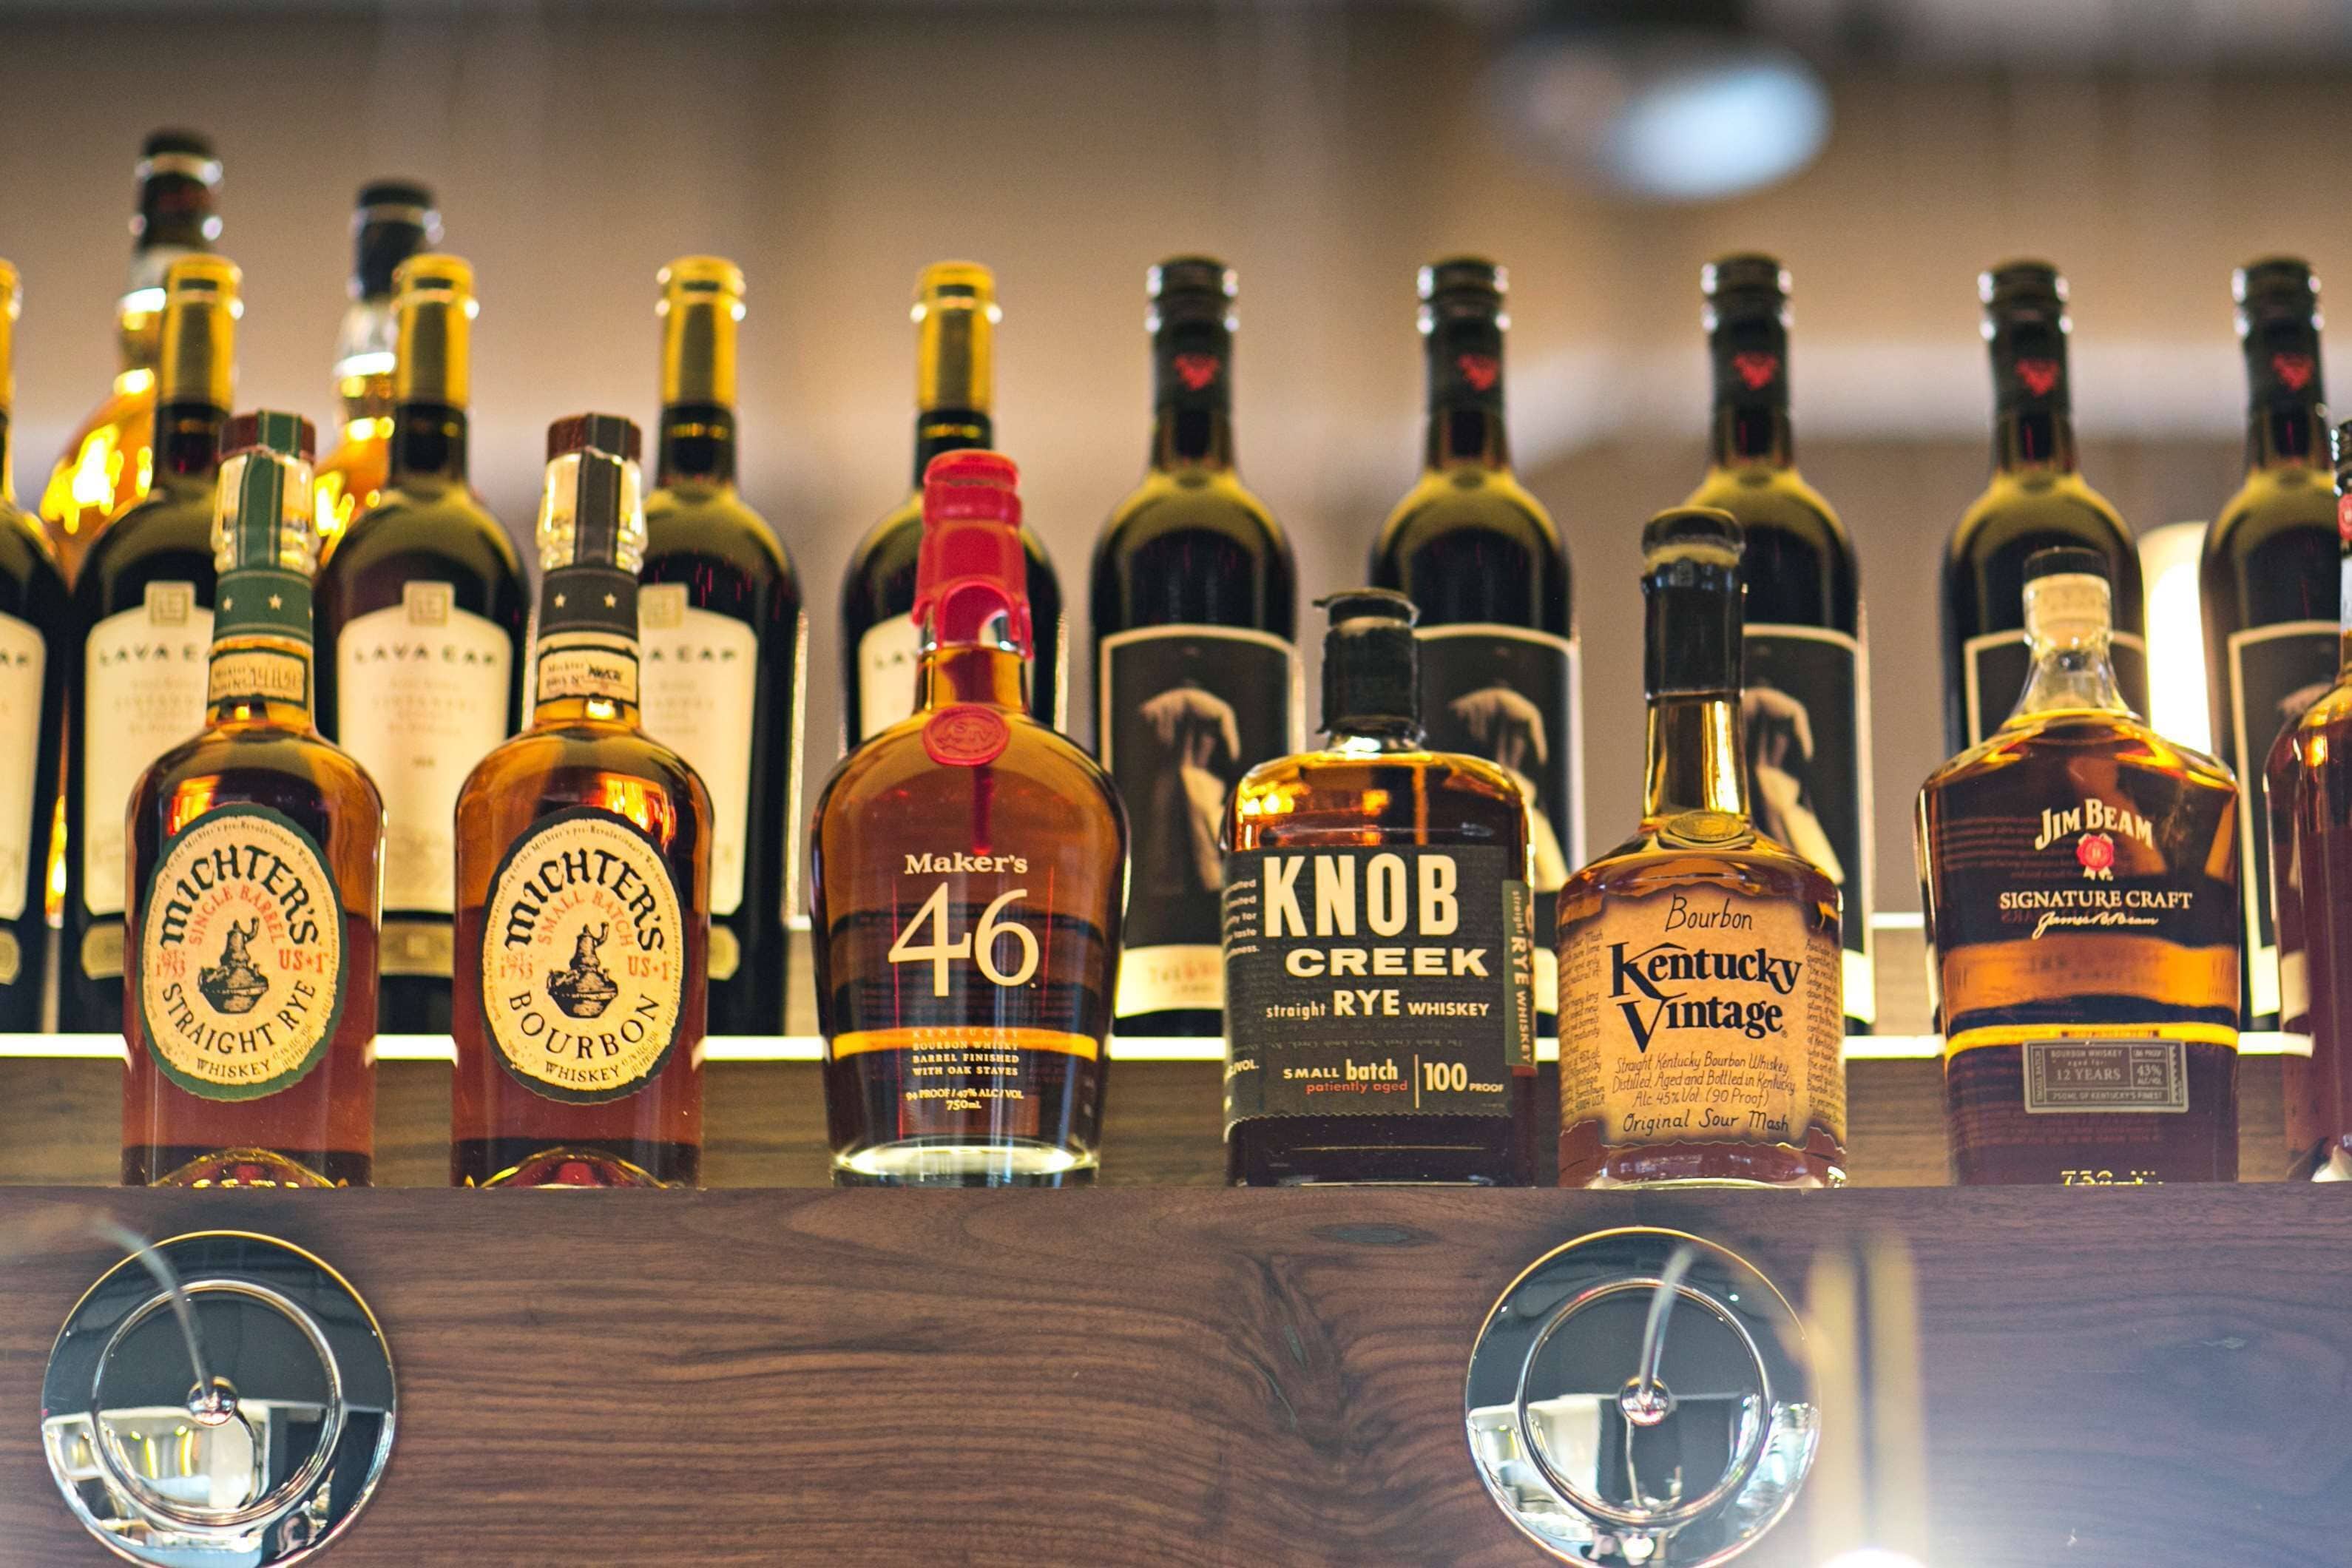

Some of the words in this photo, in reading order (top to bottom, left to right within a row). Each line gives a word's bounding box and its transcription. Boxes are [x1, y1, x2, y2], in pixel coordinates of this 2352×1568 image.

[2035, 807, 2081, 851] JIM
[2084, 798, 2154, 850] BEAM
[904, 853, 1028, 875] Maker's
[160, 844, 320, 950] MICHTER'S
[504, 848, 664, 951] MICHTER'S
[1263, 853, 1459, 938] KNOB
[1999, 891, 2122, 909] SIGNATURE
[2125, 891, 2193, 909] CRAFT
[189, 885, 233, 947] SINGLE
[240, 885, 285, 943] BARREL
[538, 890, 585, 945] SMALL
[592, 890, 634, 947] BATCH
[1511, 891, 1525, 934] straight
[1665, 893, 1753, 931] Bourbon
[888, 882, 1039, 997] 46
[1285, 947, 1490, 978] CREEK
[1511, 936, 1531, 986] RYE
[1606, 942, 1803, 998] Kentucky
[163, 983, 275, 1054] STRAIGHT
[277, 979, 315, 1031] RYE
[1266, 1001, 1325, 1021] straight
[1334, 989, 1400, 1016] RYE
[1408, 1002, 1490, 1017] WHISKEY
[510, 991, 660, 1060] BOURBON
[912, 1029, 1018, 1038] KENTUCKY
[1515, 990, 1532, 1063] WHISKEY
[1617, 996, 1783, 1053] Vintage
[912, 1041, 968, 1051] BOURBON
[973, 1041, 1018, 1051] WHISKY
[912, 1054, 958, 1064] BARREL
[962, 1053, 1020, 1064] FINISHED
[197, 1058, 270, 1078] WHISKEY
[545, 1061, 620, 1082] WHISKEY
[912, 1067, 943, 1076] WITH
[947, 1066, 972, 1075] OAK
[976, 1067, 1018, 1076] STAVES
[1283, 1068, 1339, 1079] SMALL
[1345, 1058, 1399, 1081] batch
[1423, 1062, 1467, 1092] 100
[1469, 1083, 1504, 1092] PROOF
[1616, 1053, 1652, 1074] Straight
[1655, 1051, 1700, 1069] Kentucky
[1704, 1051, 1746, 1067] Bourbon
[2057, 1069, 2070, 1081] 12
[2075, 1068, 2121, 1081] YEARS
[1306, 1081, 1368, 1095] patiently
[1373, 1080, 1408, 1094] aged
[1655, 1071, 1681, 1090] Aged
[1684, 1071, 1703, 1086] and
[1706, 1069, 1743, 1086] Bottled
[1744, 1074, 1755, 1087] in
[1756, 1072, 1796, 1095] Kentucky
[1656, 1090, 1680, 1104] 45%
[1706, 1087, 1728, 1103] (90
[1730, 1088, 1770, 1108] Proof)
[1622, 1109, 1690, 1137] Original
[1698, 1108, 1740, 1128] Sour
[1748, 1109, 1788, 1132] Mash
